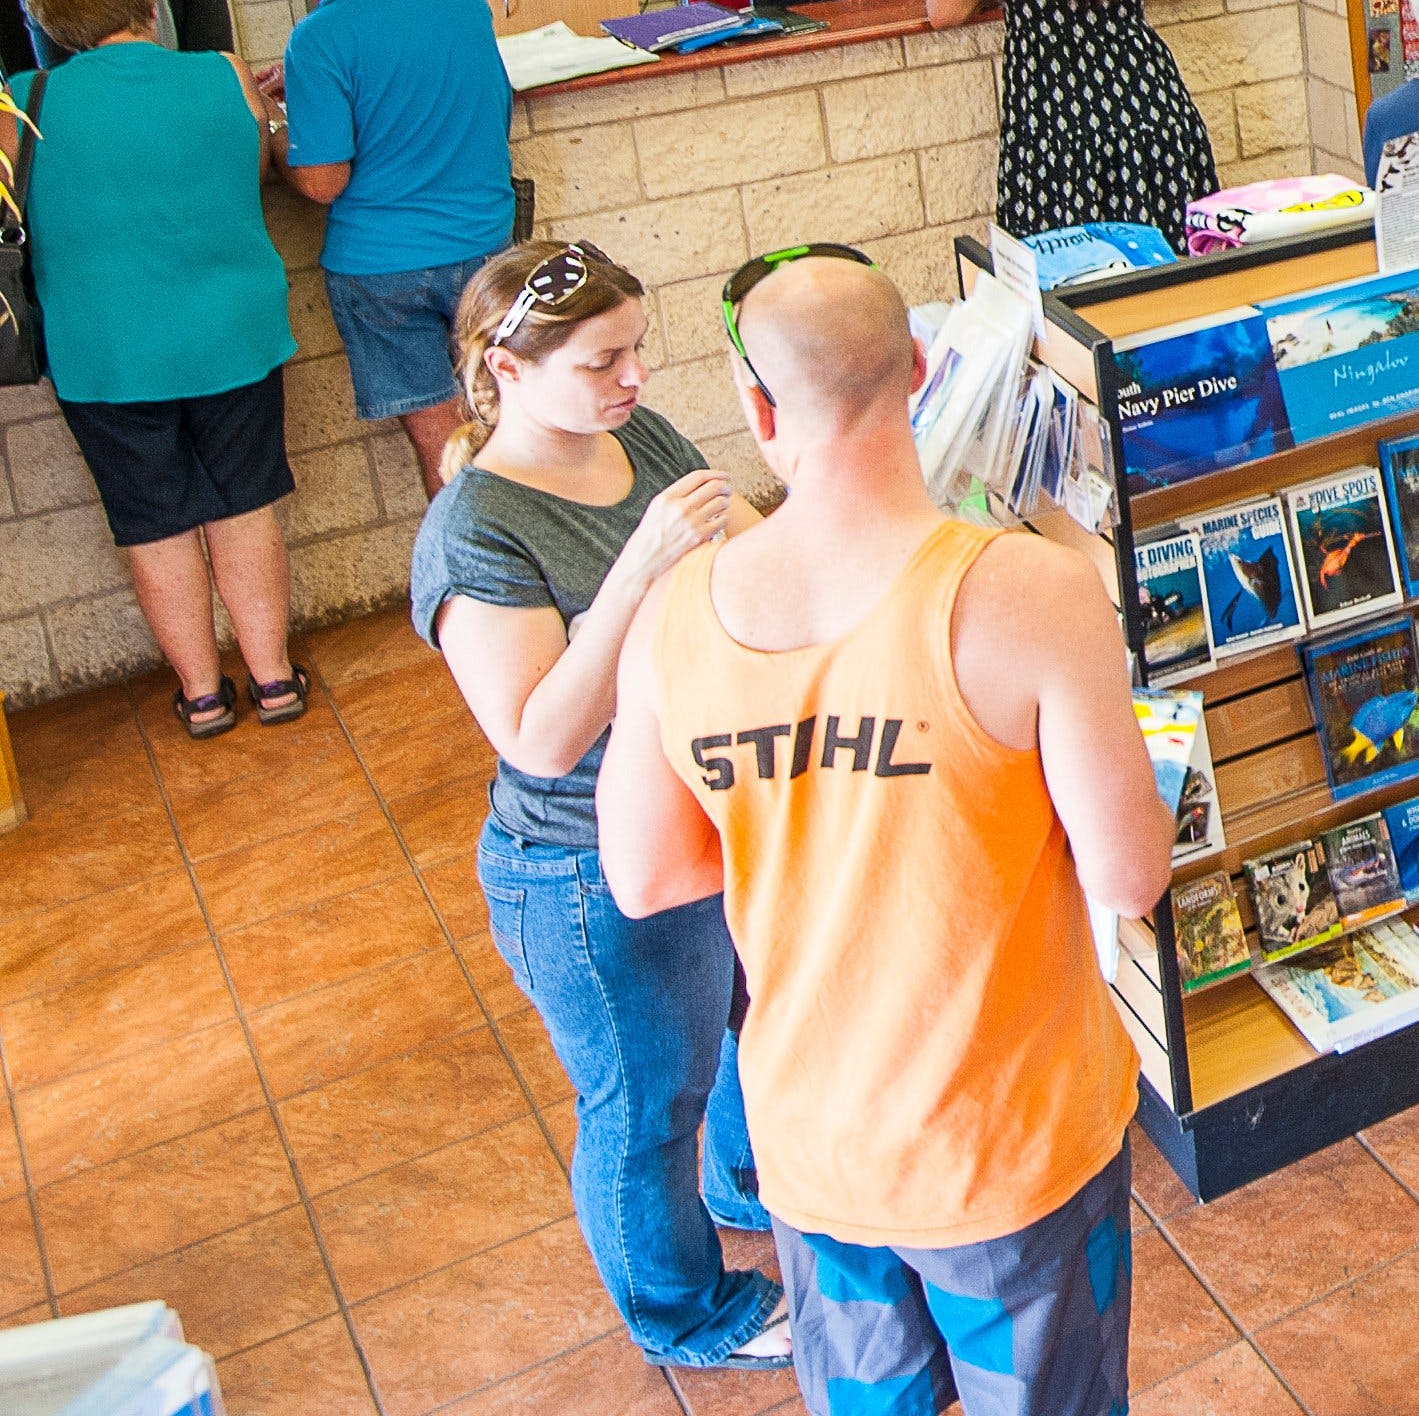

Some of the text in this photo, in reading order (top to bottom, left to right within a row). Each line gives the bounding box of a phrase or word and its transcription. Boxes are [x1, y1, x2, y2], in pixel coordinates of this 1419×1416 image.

[1333, 349, 1410, 389] Ningaloo
[1117, 382, 1142, 401] outh
[1117, 373, 1239, 421] Navy Pier Dive
[1315, 486, 1340, 504] DIVE
[1341, 475, 1378, 497] SPOTS
[1202, 503, 1280, 535] MARINE SPECIES
[1149, 538, 1194, 566] DIVING
[690, 713, 932, 791] STIHL
